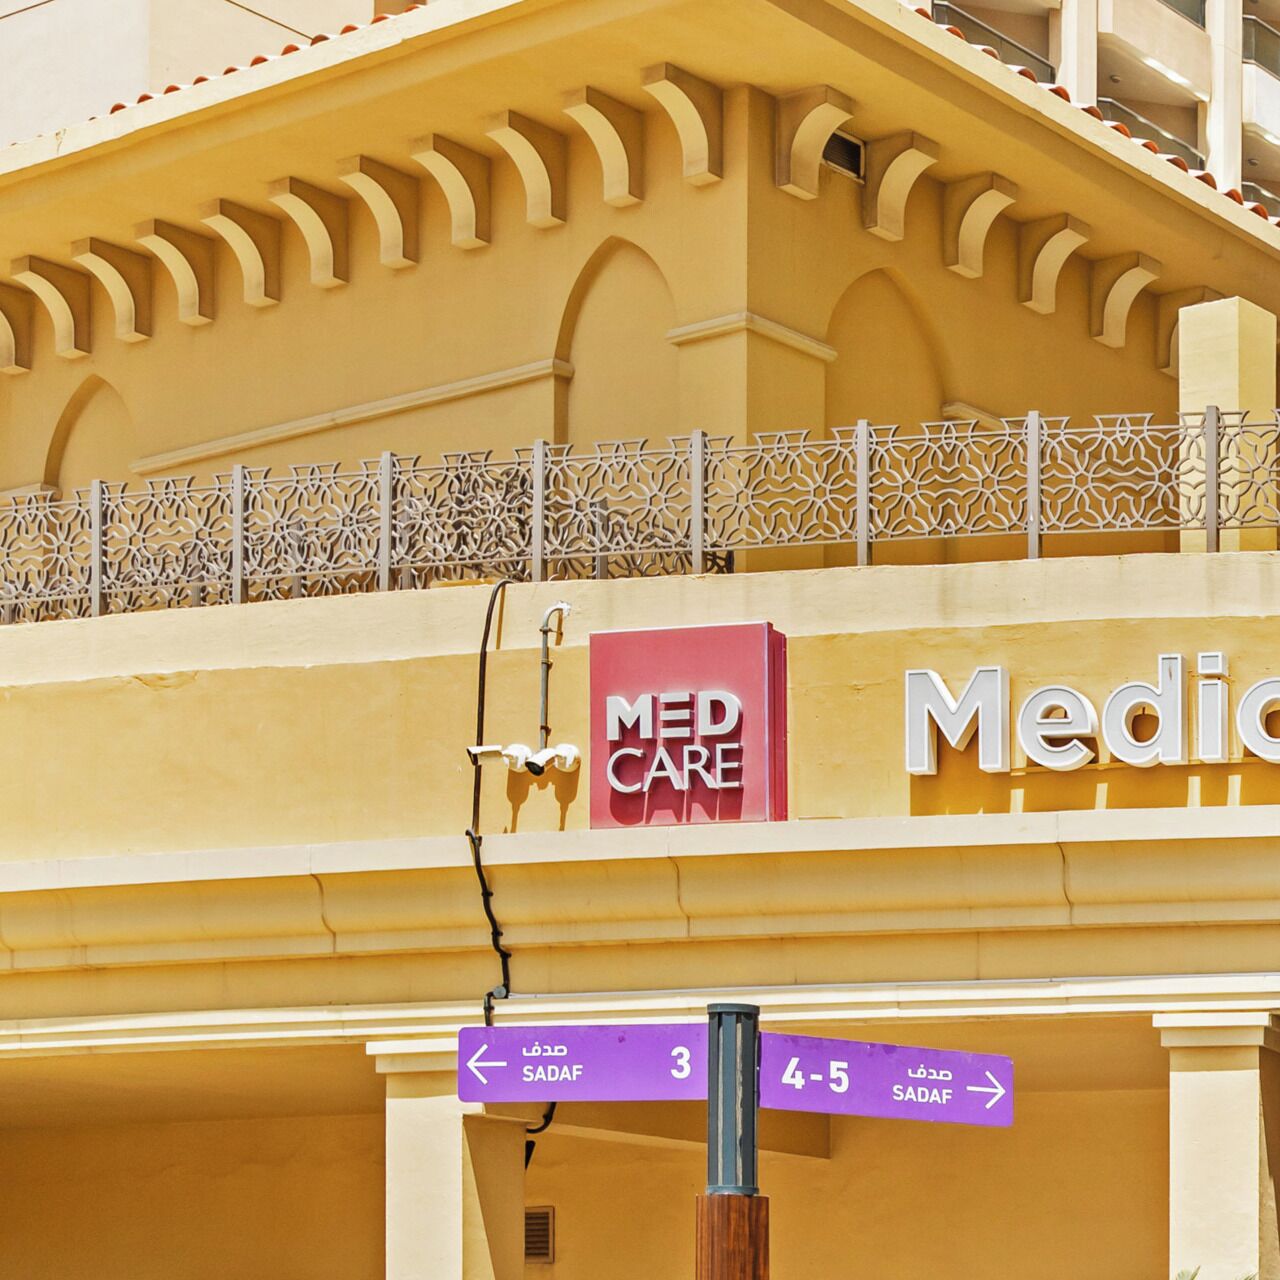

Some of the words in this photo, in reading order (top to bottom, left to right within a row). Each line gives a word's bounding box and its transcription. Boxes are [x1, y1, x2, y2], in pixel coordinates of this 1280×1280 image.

[605, 690, 745, 741] MED
[606, 743, 745, 794] CARE
[522, 1041, 568, 1057] صدف
[670, 1045, 692, 1079] 3
[522, 1065, 584, 1082] SADAF
[781, 1057, 850, 1094] 4-5
[907, 1064, 953, 1081] صدف
[892, 1084, 953, 1105] SADAF
